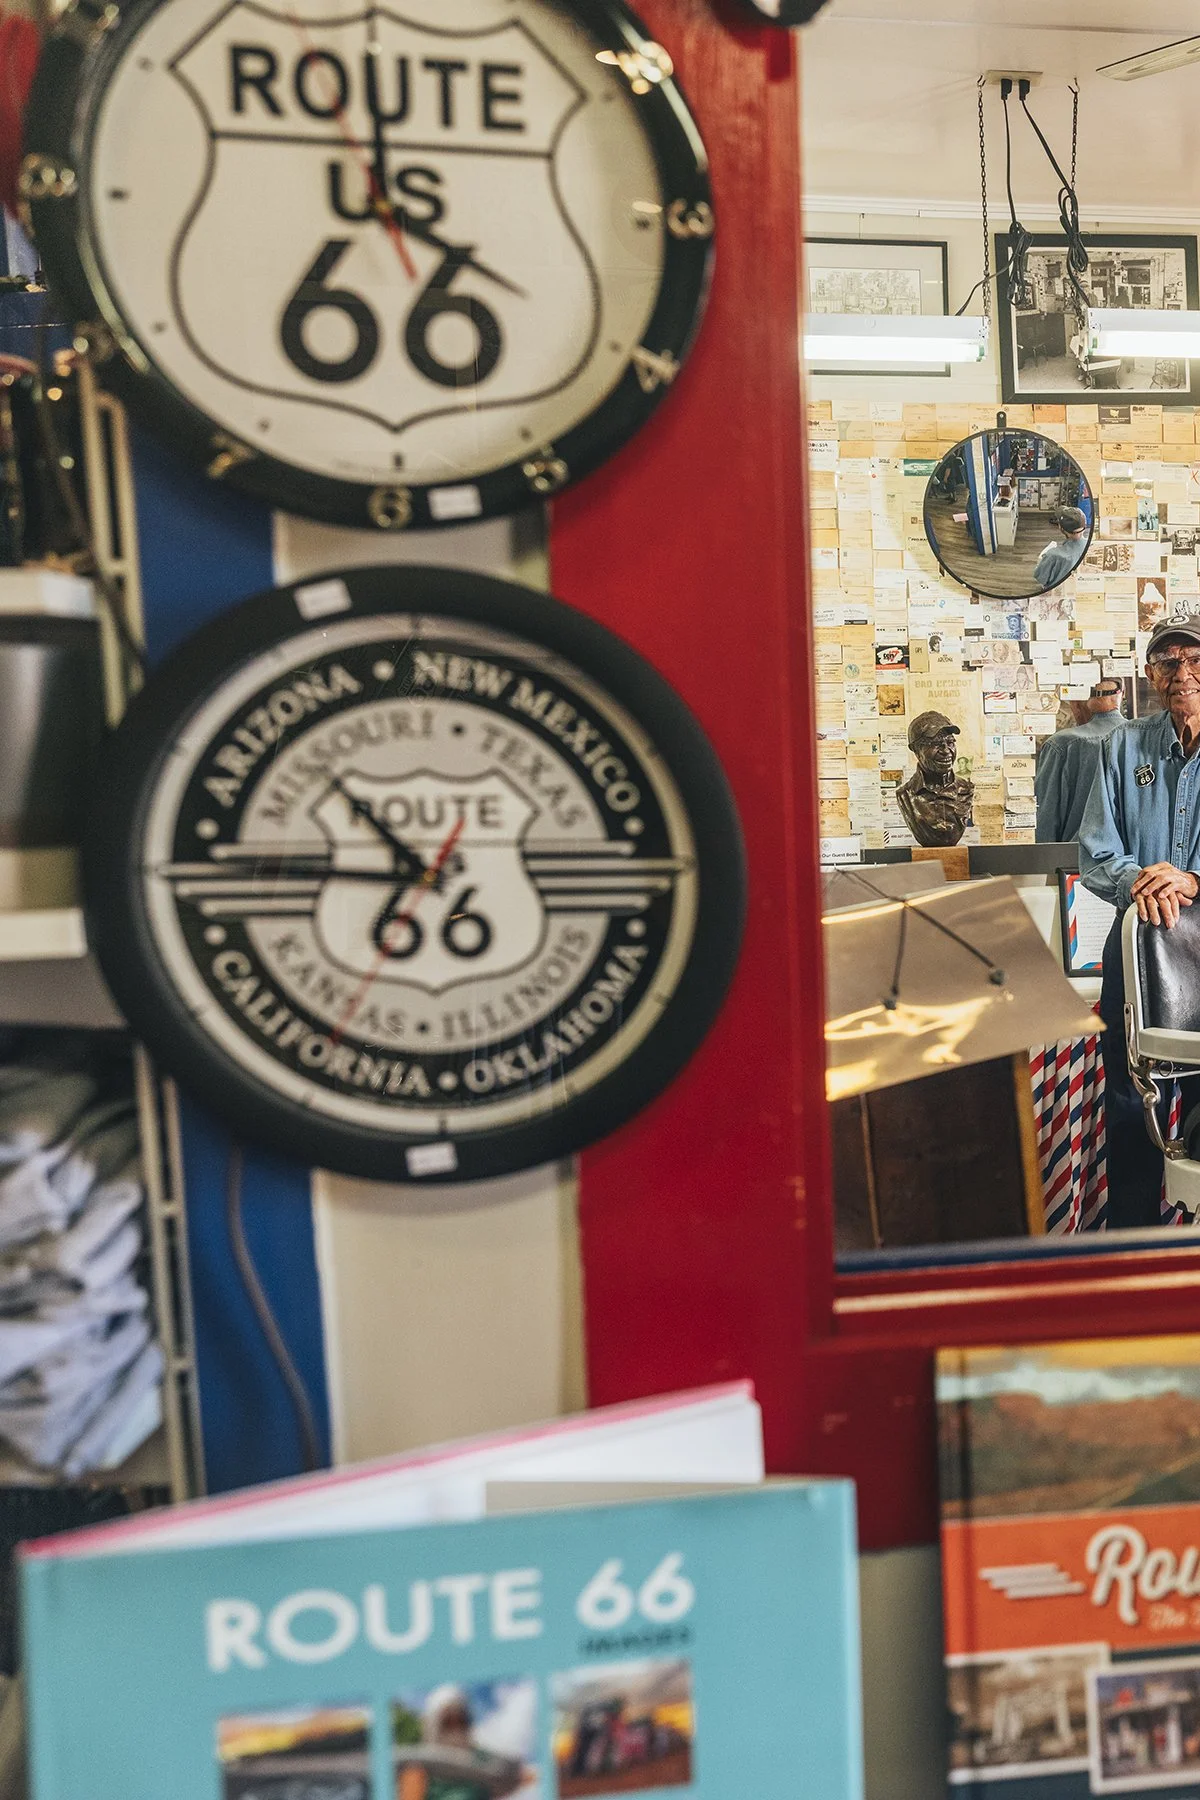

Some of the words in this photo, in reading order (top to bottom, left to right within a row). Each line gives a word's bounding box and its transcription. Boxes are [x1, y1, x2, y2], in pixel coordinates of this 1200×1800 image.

[226, 43, 528, 134] ROUTE
[327, 160, 447, 224] US
[279, 240, 502, 387] 66
[204, 663, 364, 808] ARIZONA
[259, 708, 435, 826] MISSOURI
[412, 651, 513, 698] NEW
[511, 677, 642, 813] MEXICO
[480, 722, 589, 829] TEXAS
[1140, 775, 1151, 784] 66
[371, 885, 493, 961] 66
[211, 951, 431, 1097] CALIFORNIA
[271, 929, 408, 1036] KANSAS
[441, 925, 591, 1041] ILLINOIS
[463, 943, 649, 1093] OKLAHOMA
[205, 1568, 543, 1673] ROUTE
[576, 1551, 695, 1629] 66
